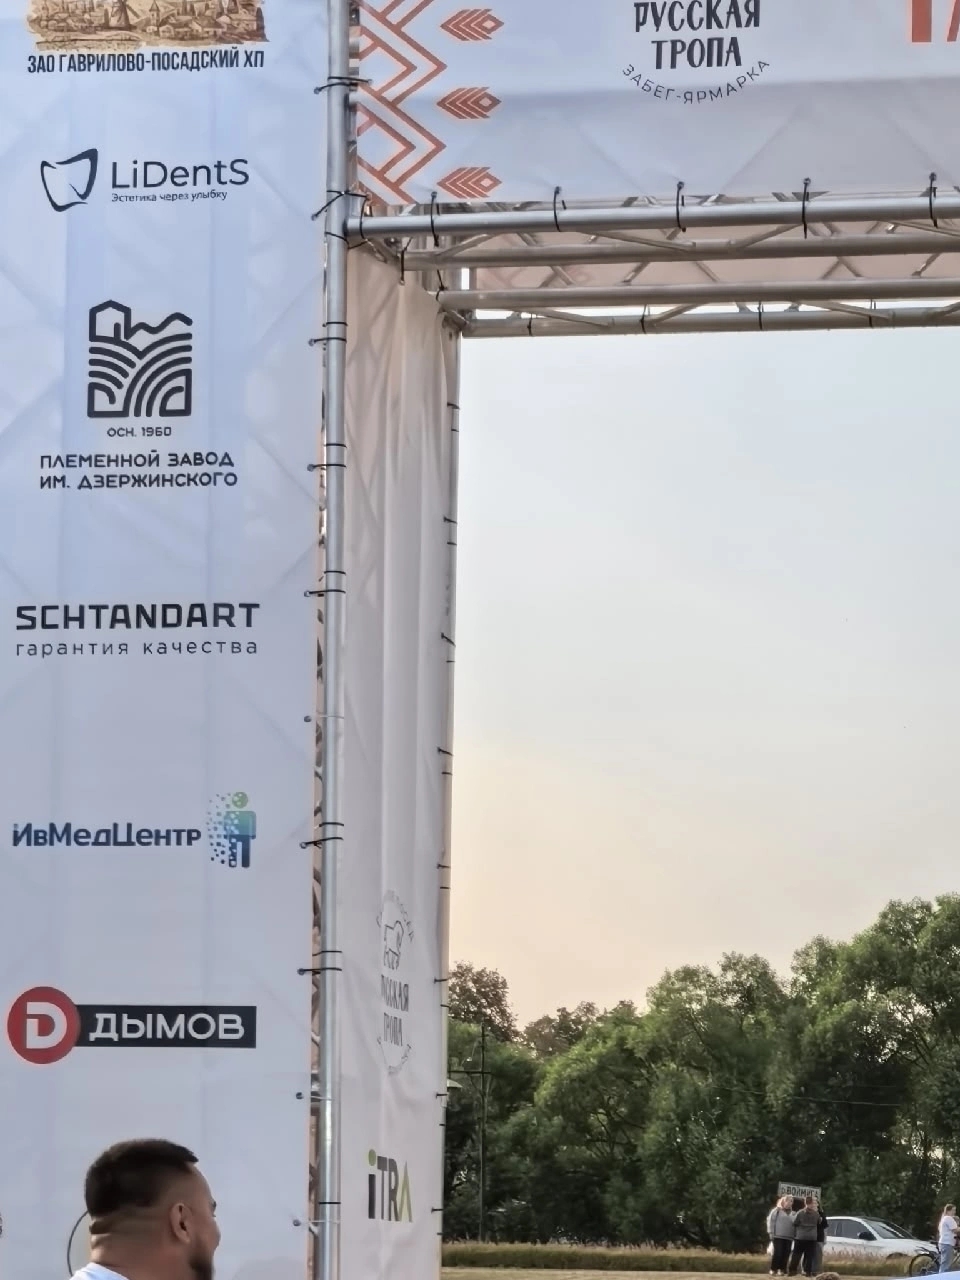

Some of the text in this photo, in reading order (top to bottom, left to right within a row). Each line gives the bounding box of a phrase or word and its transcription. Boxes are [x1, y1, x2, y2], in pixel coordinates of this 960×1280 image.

[634, 0, 761, 32] РУССКАЯ
[27, 48, 265, 73] ЗАО ГАВРИЛОВО-ПОСАДСКИЙ ХП
[650, 37, 742, 70] ТРОПА
[622, 58, 770, 104] ЗАБЕГ-ЯРМАРКА
[111, 159, 250, 189] LiDentS
[111, 190, 228, 203] Эстетика через улыбку
[107, 426, 172, 437] ОСН. 1960
[40, 449, 235, 469] ПЛЕМЕННОЙ ЗАВОД
[40, 472, 238, 490] ИМ. ДЗЕРЖИНСКОГО
[16, 603, 260, 630] SCHTANDART
[16, 640, 258, 658] гарантия качества
[12, 822, 201, 849] ИвМедЦентр
[89, 1013, 245, 1042] ДЫМОВ
